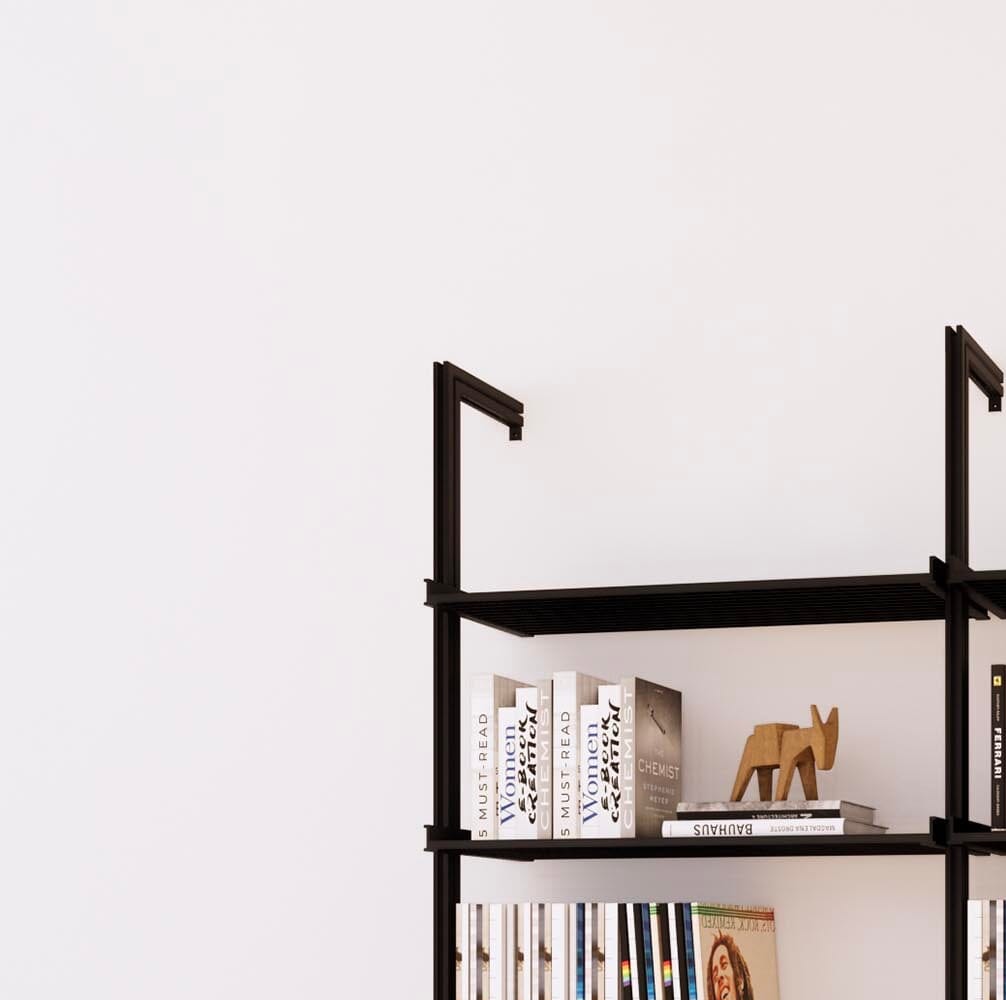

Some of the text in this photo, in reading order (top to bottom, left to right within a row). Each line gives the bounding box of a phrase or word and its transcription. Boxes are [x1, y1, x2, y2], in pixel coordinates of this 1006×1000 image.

[478, 713, 488, 838] 5 MUST-READ
[500, 725, 516, 826] Women
[518, 715, 528, 813] E-BOOK
[526, 701, 538, 825] CREATION
[540, 687, 550, 831] CHEMIST
[560, 711, 571, 837] 5 MUST-READ
[582, 723, 599, 825] Women
[601, 712, 611, 811] E-BOOK
[609, 698, 621, 823] CREATION
[623, 688, 633, 830] CHEMIST
[638, 759, 680, 781] CHEMIST
[993, 727, 1002, 779] FERRARI
[693, 823, 753, 836] BAUHAUS
